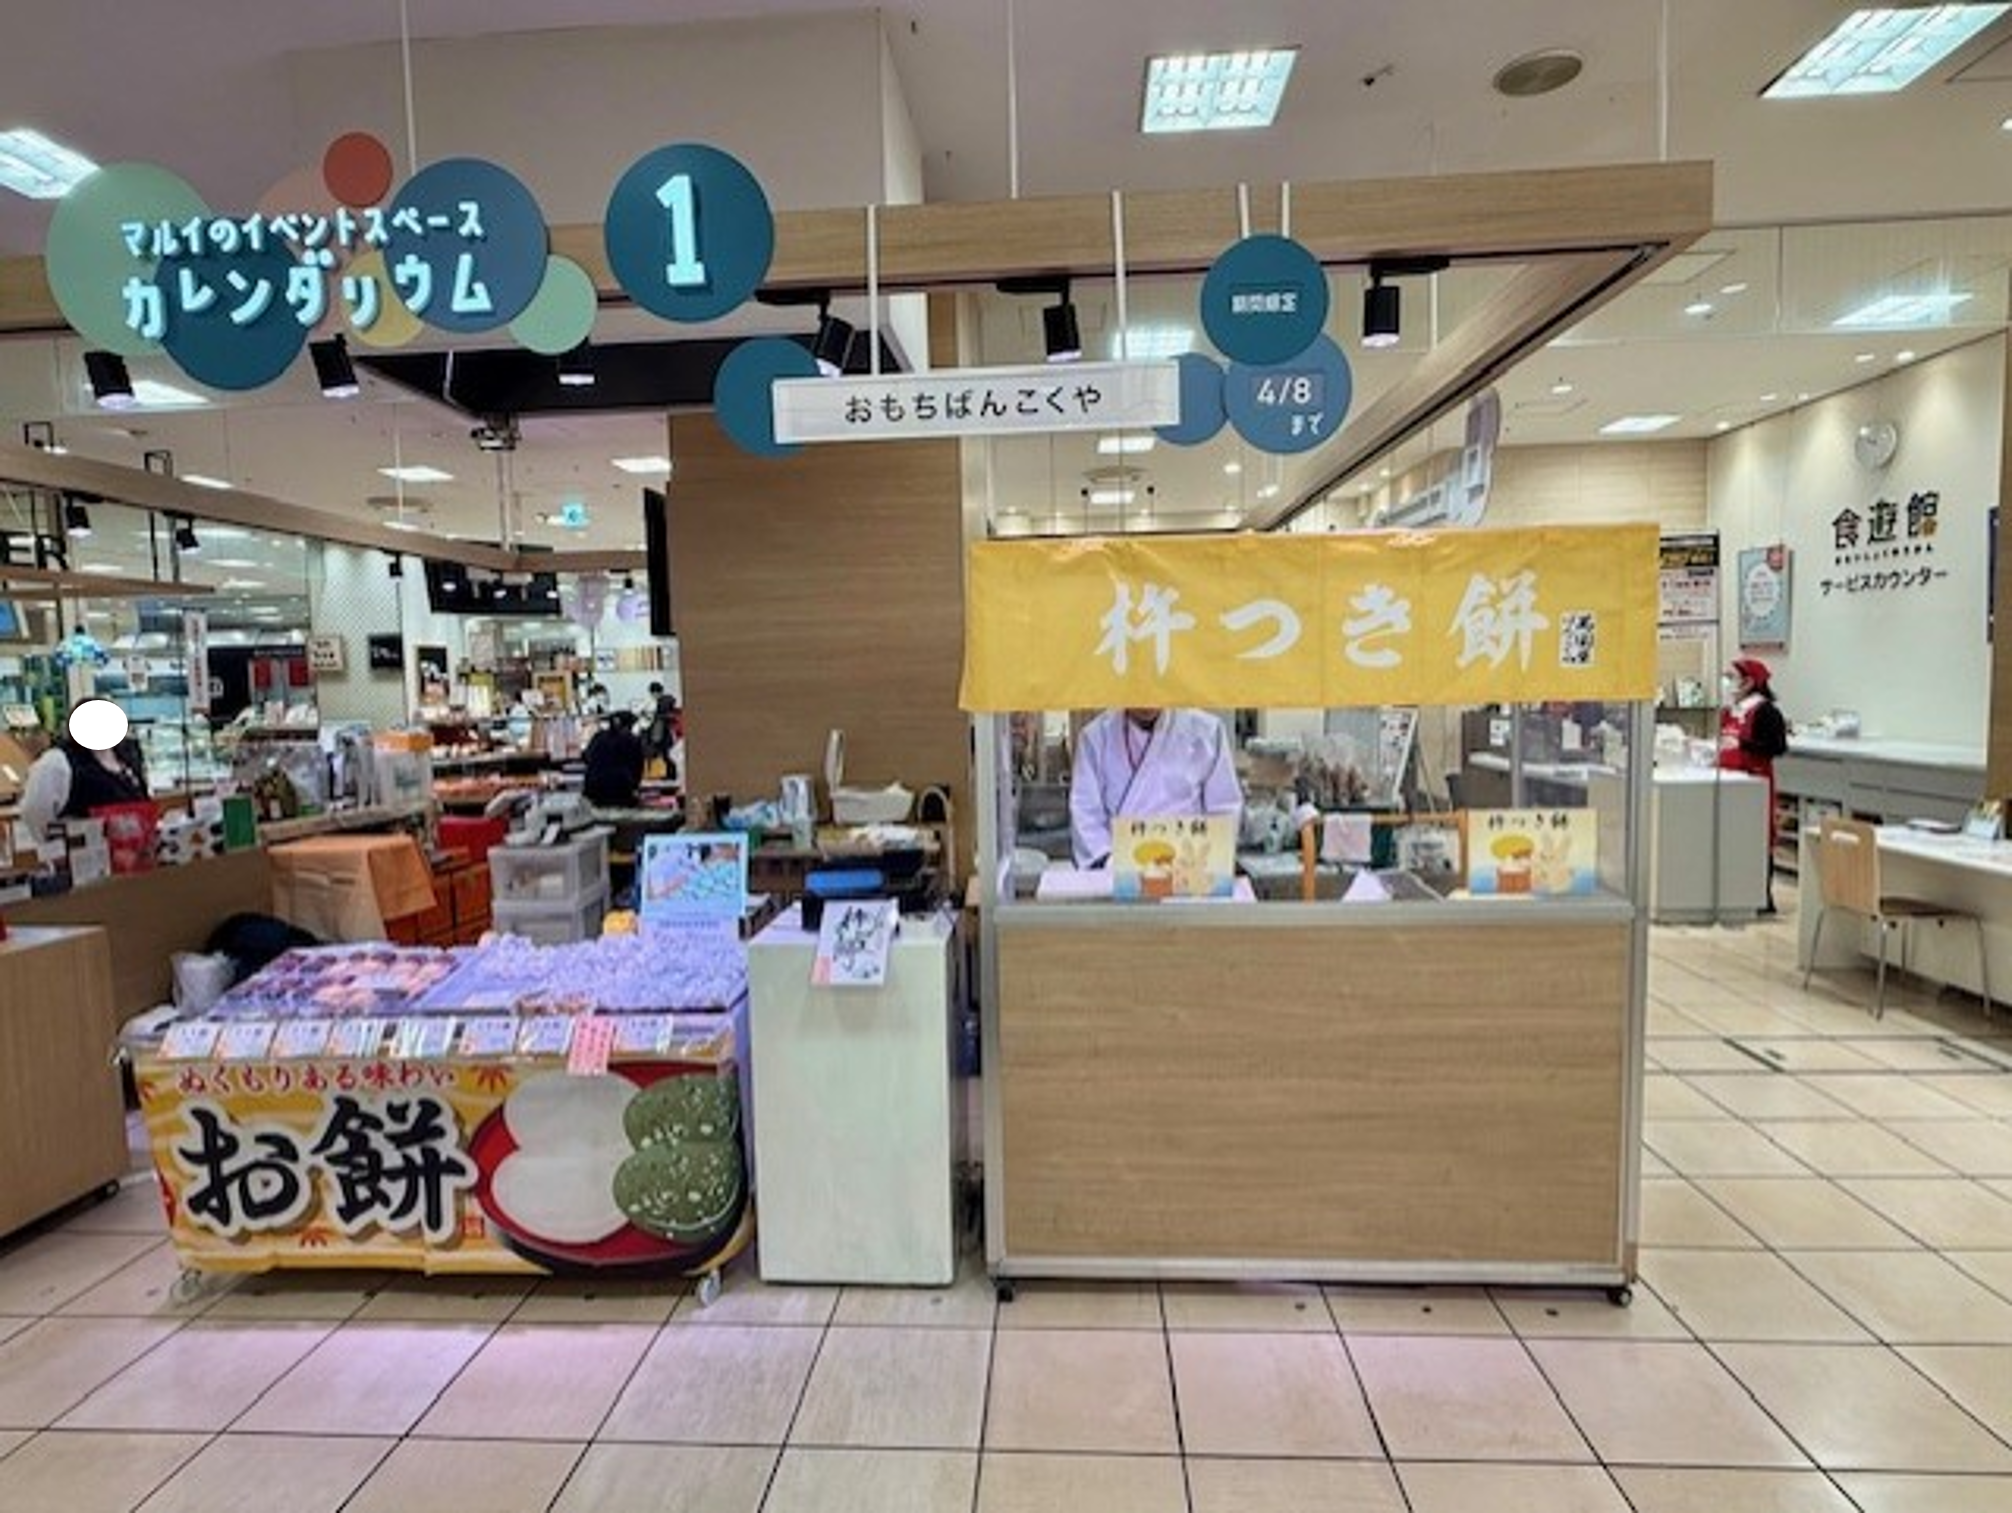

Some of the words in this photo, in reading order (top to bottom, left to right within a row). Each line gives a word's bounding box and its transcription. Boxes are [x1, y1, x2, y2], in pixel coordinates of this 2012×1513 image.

[120, 200, 485, 256] マルイのイベントスペース
[653, 175, 706, 288] 1
[120, 249, 494, 338] カレンダリウム
[844, 385, 1102, 424] おもちばんこくや
[1256, 376, 1312, 405] 4/8
[1832, 491, 1939, 549] 食遊館
[1819, 566, 1948, 596] サービスカウンター
[1095, 571, 1551, 676] 杵つき餅
[178, 1062, 456, 1095] ぬくもりある味わい
[178, 1098, 466, 1232] お餅
